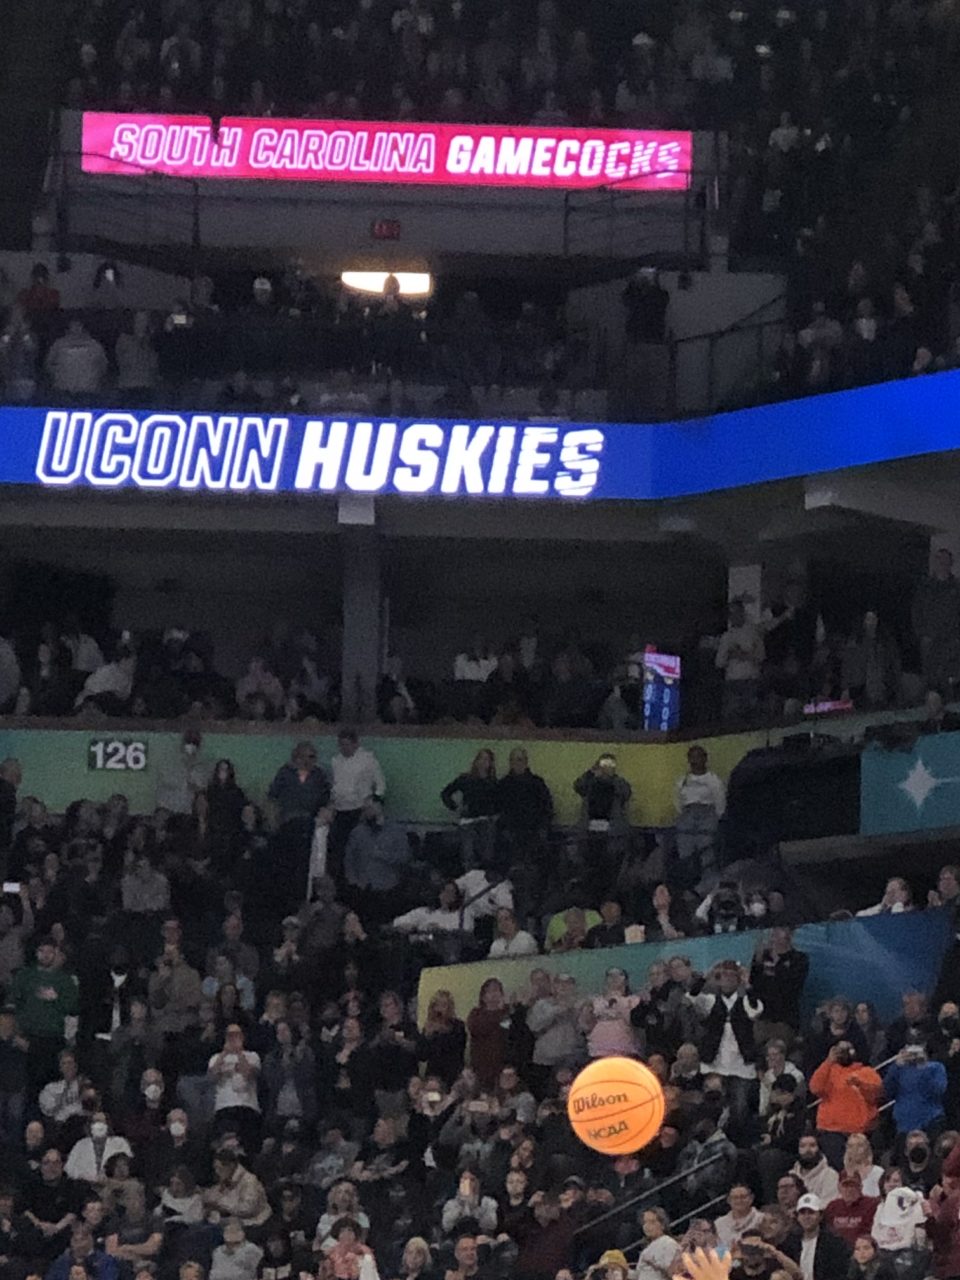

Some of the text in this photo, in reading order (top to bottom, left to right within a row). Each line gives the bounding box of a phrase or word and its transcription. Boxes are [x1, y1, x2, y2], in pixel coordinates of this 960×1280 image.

[110, 123, 681, 179] SOUTH CAROLINA GAMECOCKS
[36, 411, 605, 497] UCONN HUSKIES
[90, 741, 146, 770] 126
[573, 1093, 629, 1115] Wilson
[588, 1120, 630, 1140] NCAA
